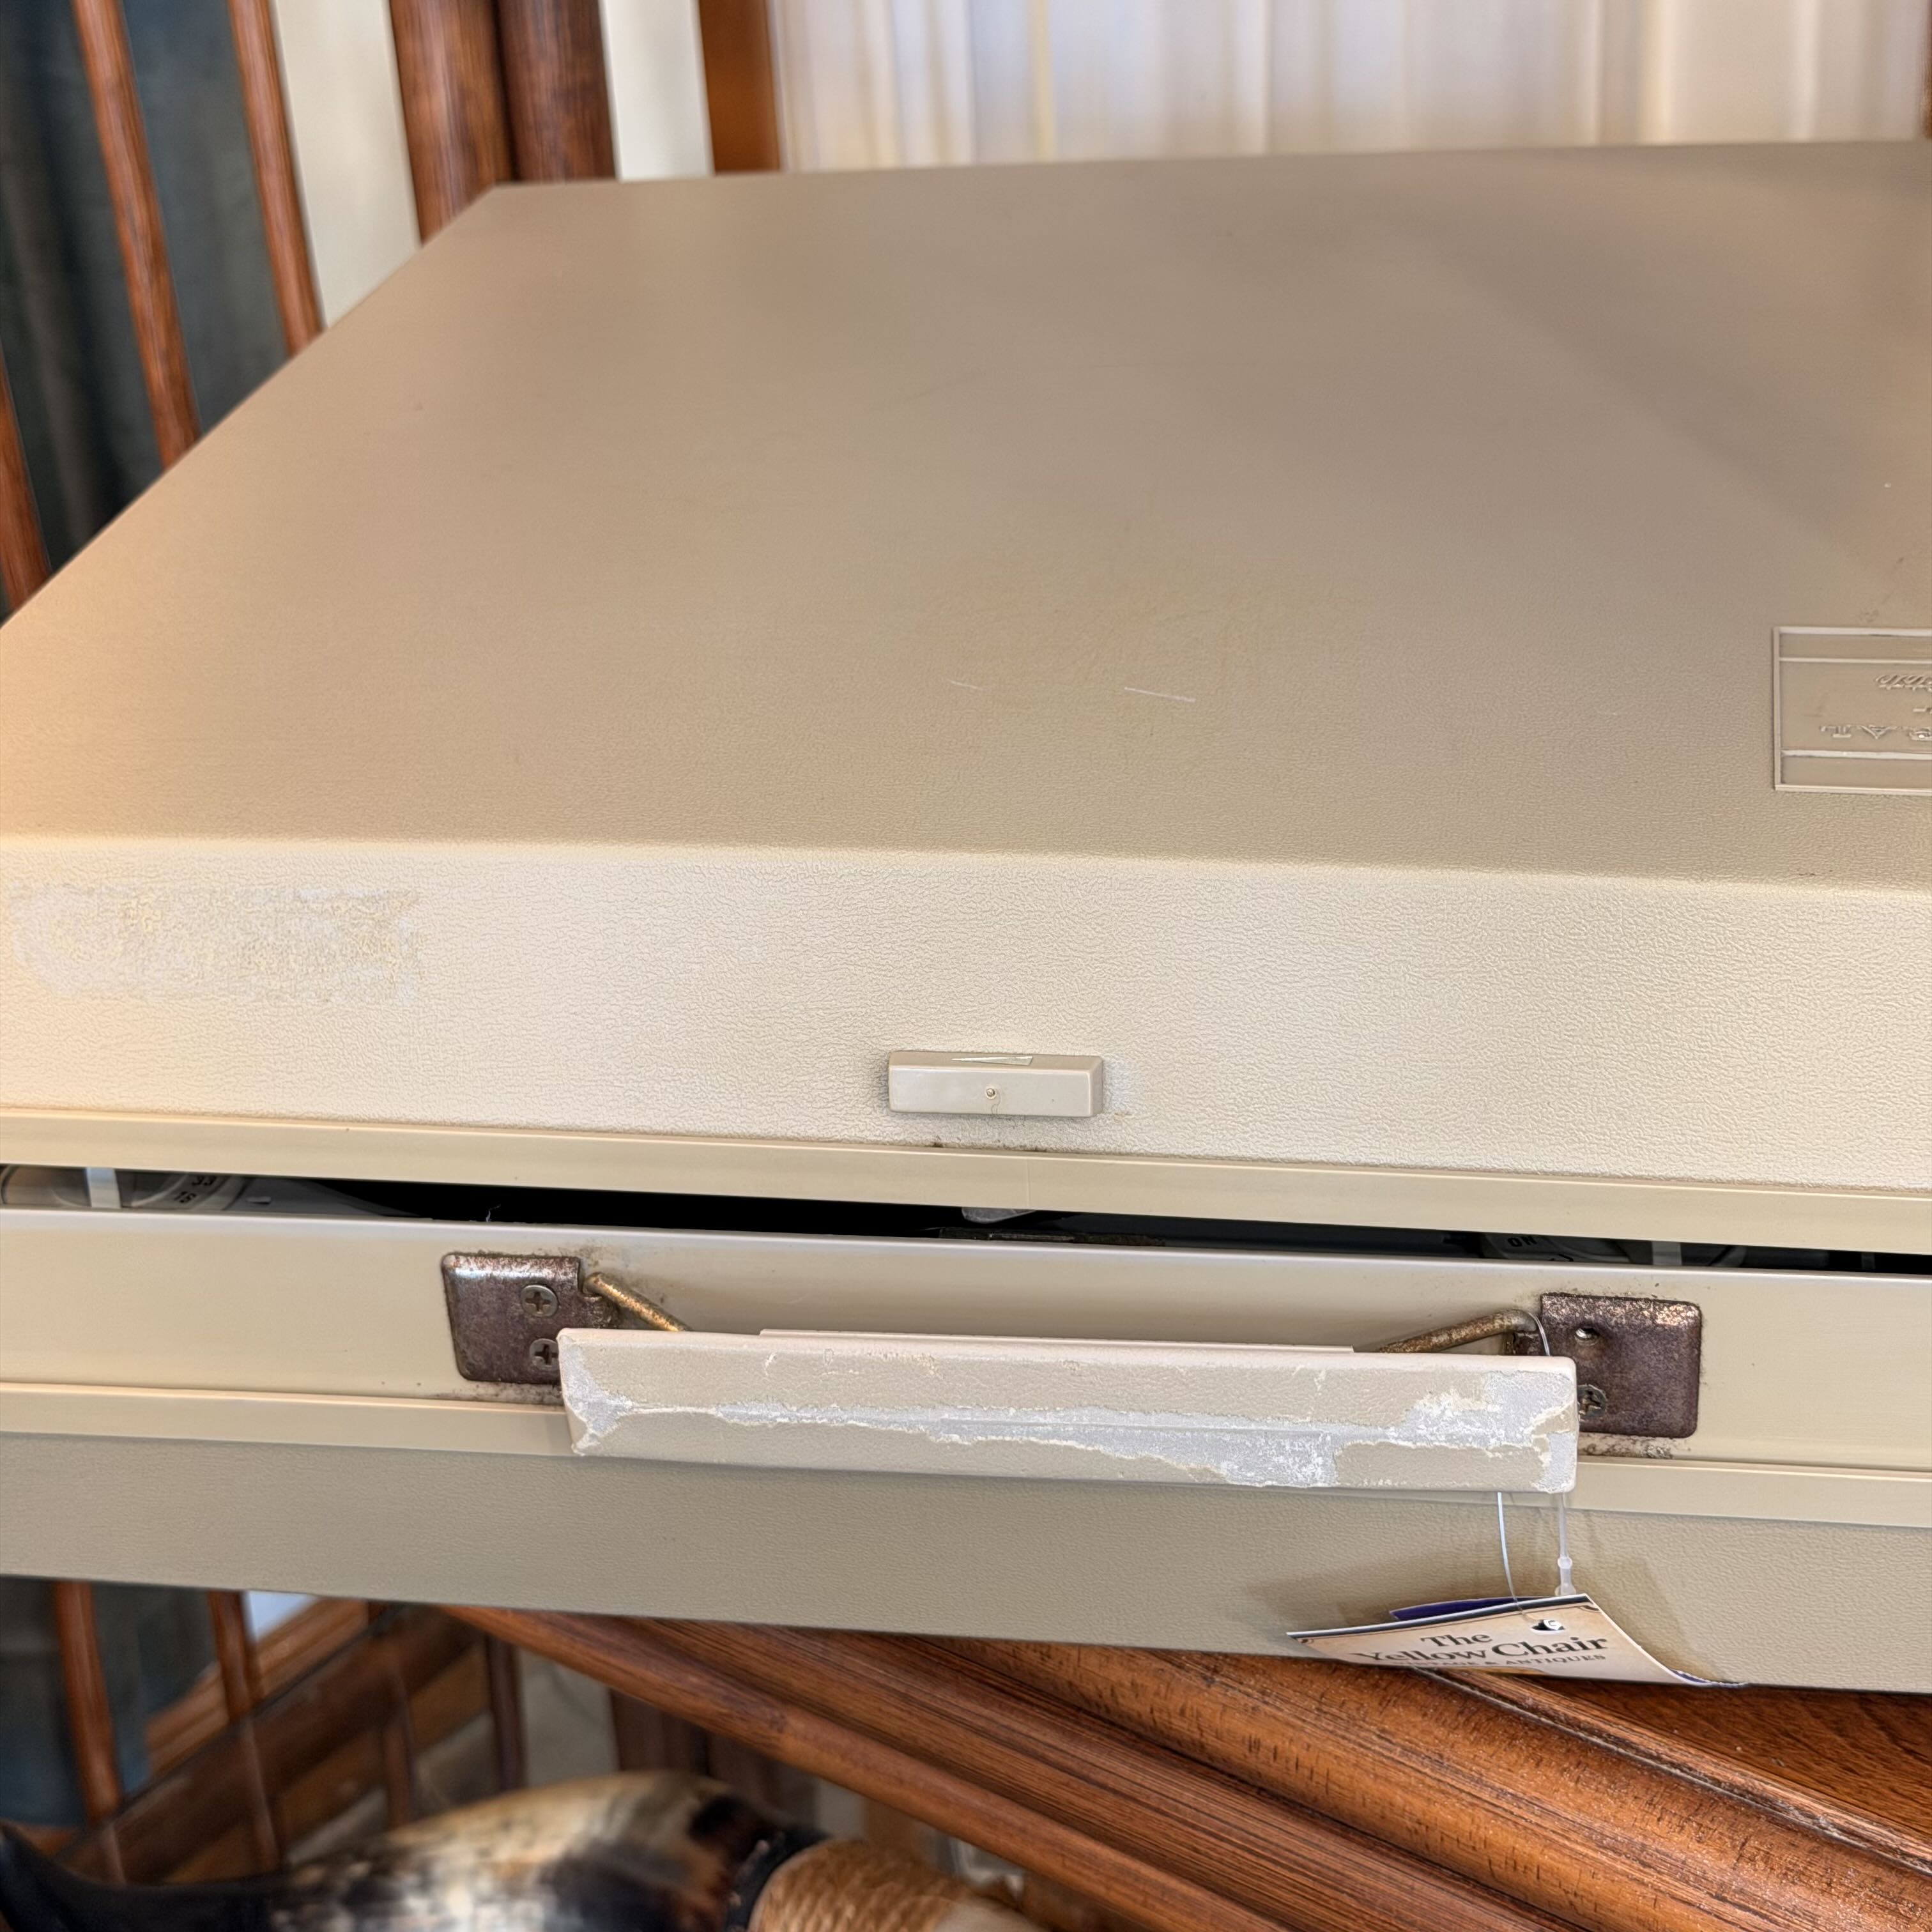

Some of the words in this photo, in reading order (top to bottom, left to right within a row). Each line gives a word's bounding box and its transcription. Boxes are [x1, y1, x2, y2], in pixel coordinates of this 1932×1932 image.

[1420, 1635, 1492, 1646] The
[1352, 1650, 1487, 1660] Yellow
[1492, 1636, 1608, 1657] Chair
[1506, 1655, 1606, 1665] ANTIQUES
